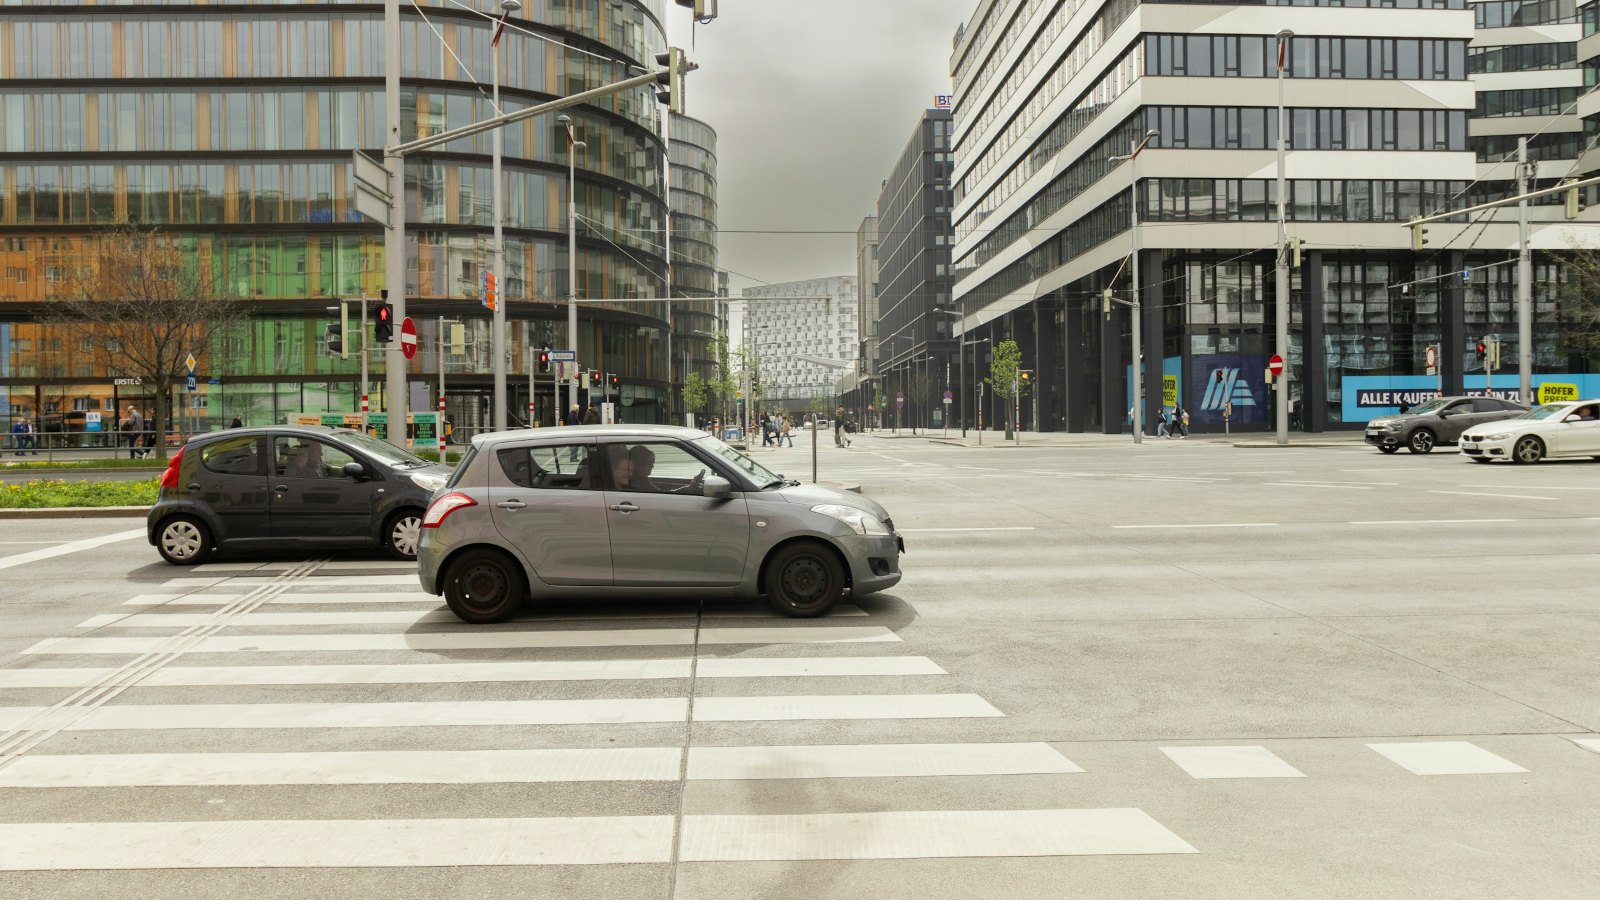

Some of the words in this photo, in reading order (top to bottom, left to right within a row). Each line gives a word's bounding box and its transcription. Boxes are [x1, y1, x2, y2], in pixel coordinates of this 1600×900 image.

[1508, 391, 1534, 402] ZU
[1544, 386, 1574, 396] HOFER
[1361, 392, 1390, 405] ALLE
